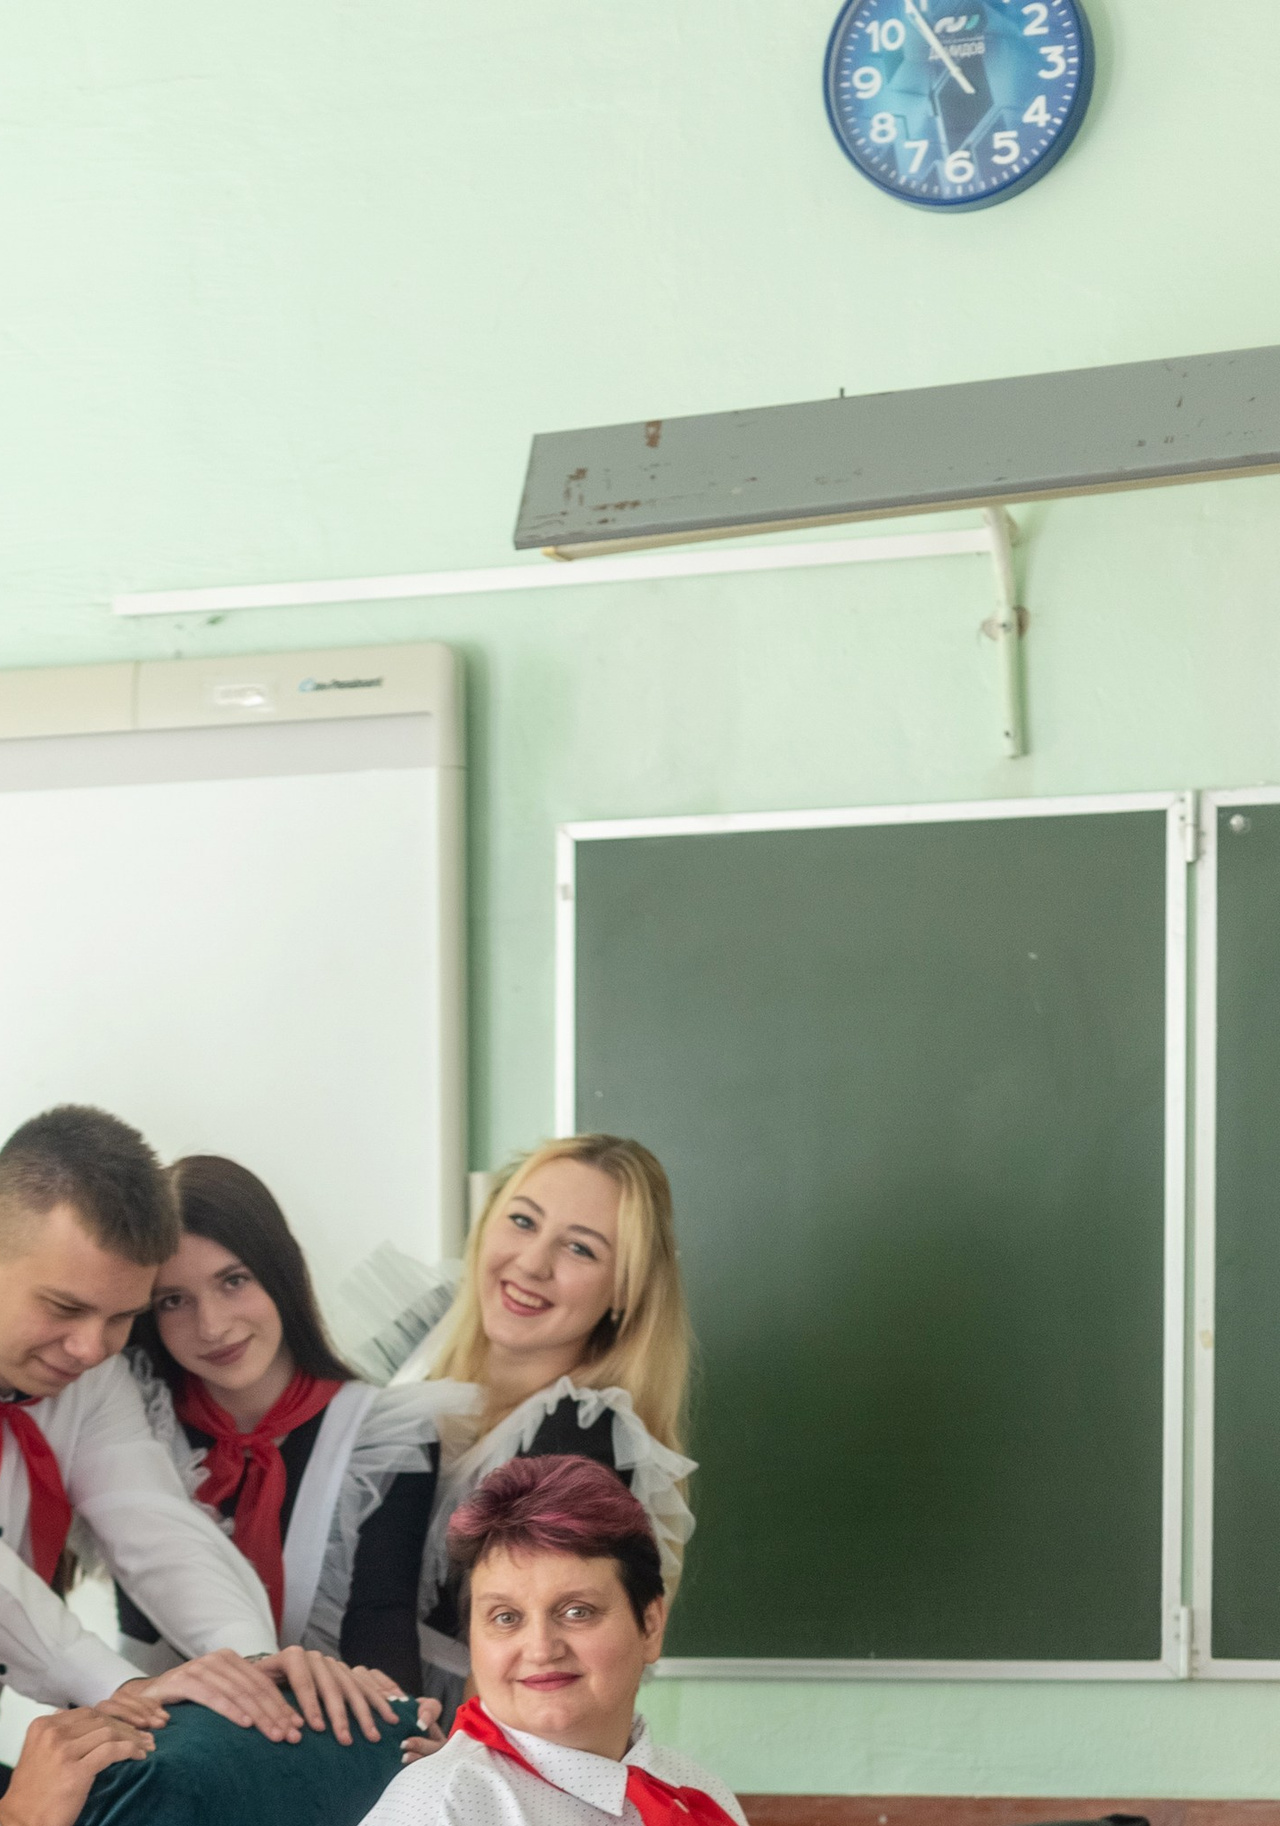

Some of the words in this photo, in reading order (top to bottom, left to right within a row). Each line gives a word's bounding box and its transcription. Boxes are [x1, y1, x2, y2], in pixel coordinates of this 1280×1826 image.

[865, 18, 905, 52] 10
[1022, 3, 1049, 36] 2
[1038, 45, 1066, 79] 3
[852, 66, 882, 99] 9
[869, 112, 897, 143] 8
[1022, 95, 1051, 127] 4
[904, 140, 928, 173] 7
[992, 131, 1020, 164] 5
[944, 150, 974, 183] 6
